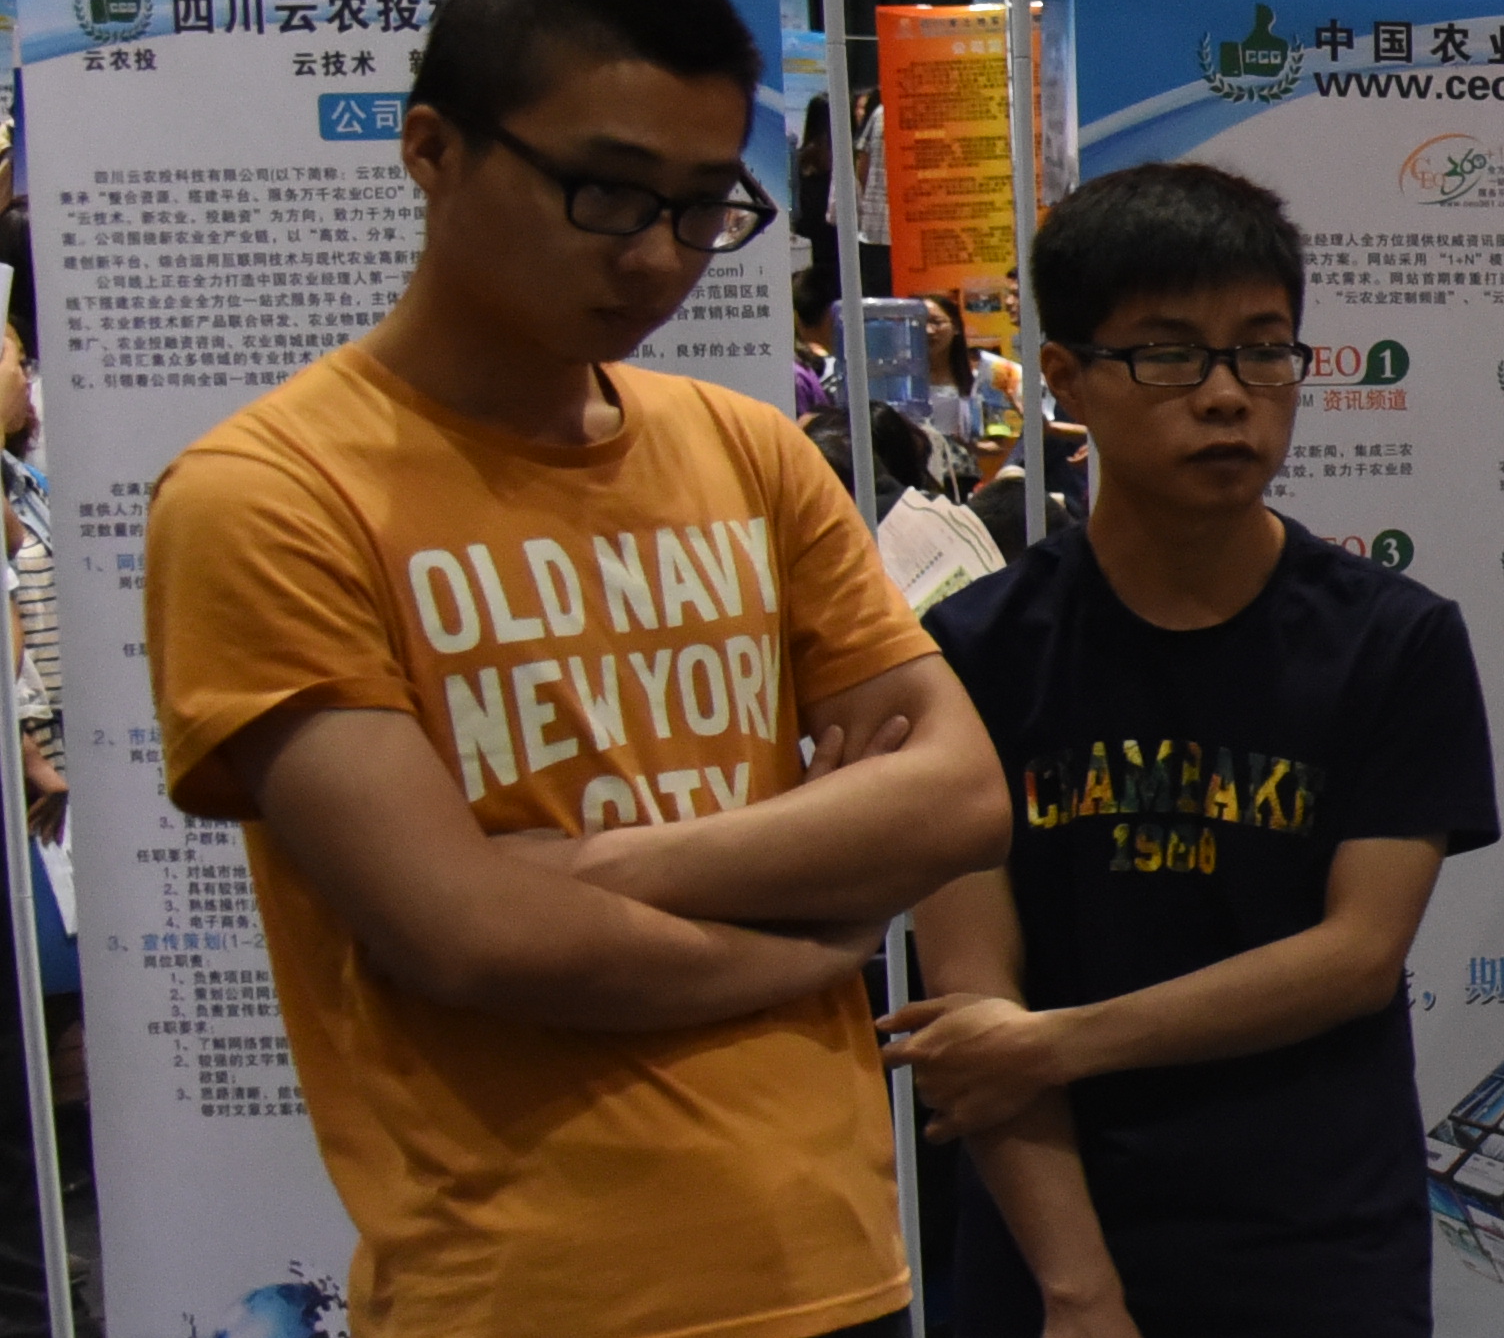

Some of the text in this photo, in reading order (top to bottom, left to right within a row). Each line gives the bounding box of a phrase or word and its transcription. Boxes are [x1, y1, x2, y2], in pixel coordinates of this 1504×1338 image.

[84, 48, 158, 72] 云农投
[292, 50, 376, 77] 云技术
[1379, 348, 1396, 379] 1
[1323, 389, 1408, 412] 资讯频道
[408, 517, 778, 654] OLD NAVY
[446, 635, 781, 801] NEW YORK
